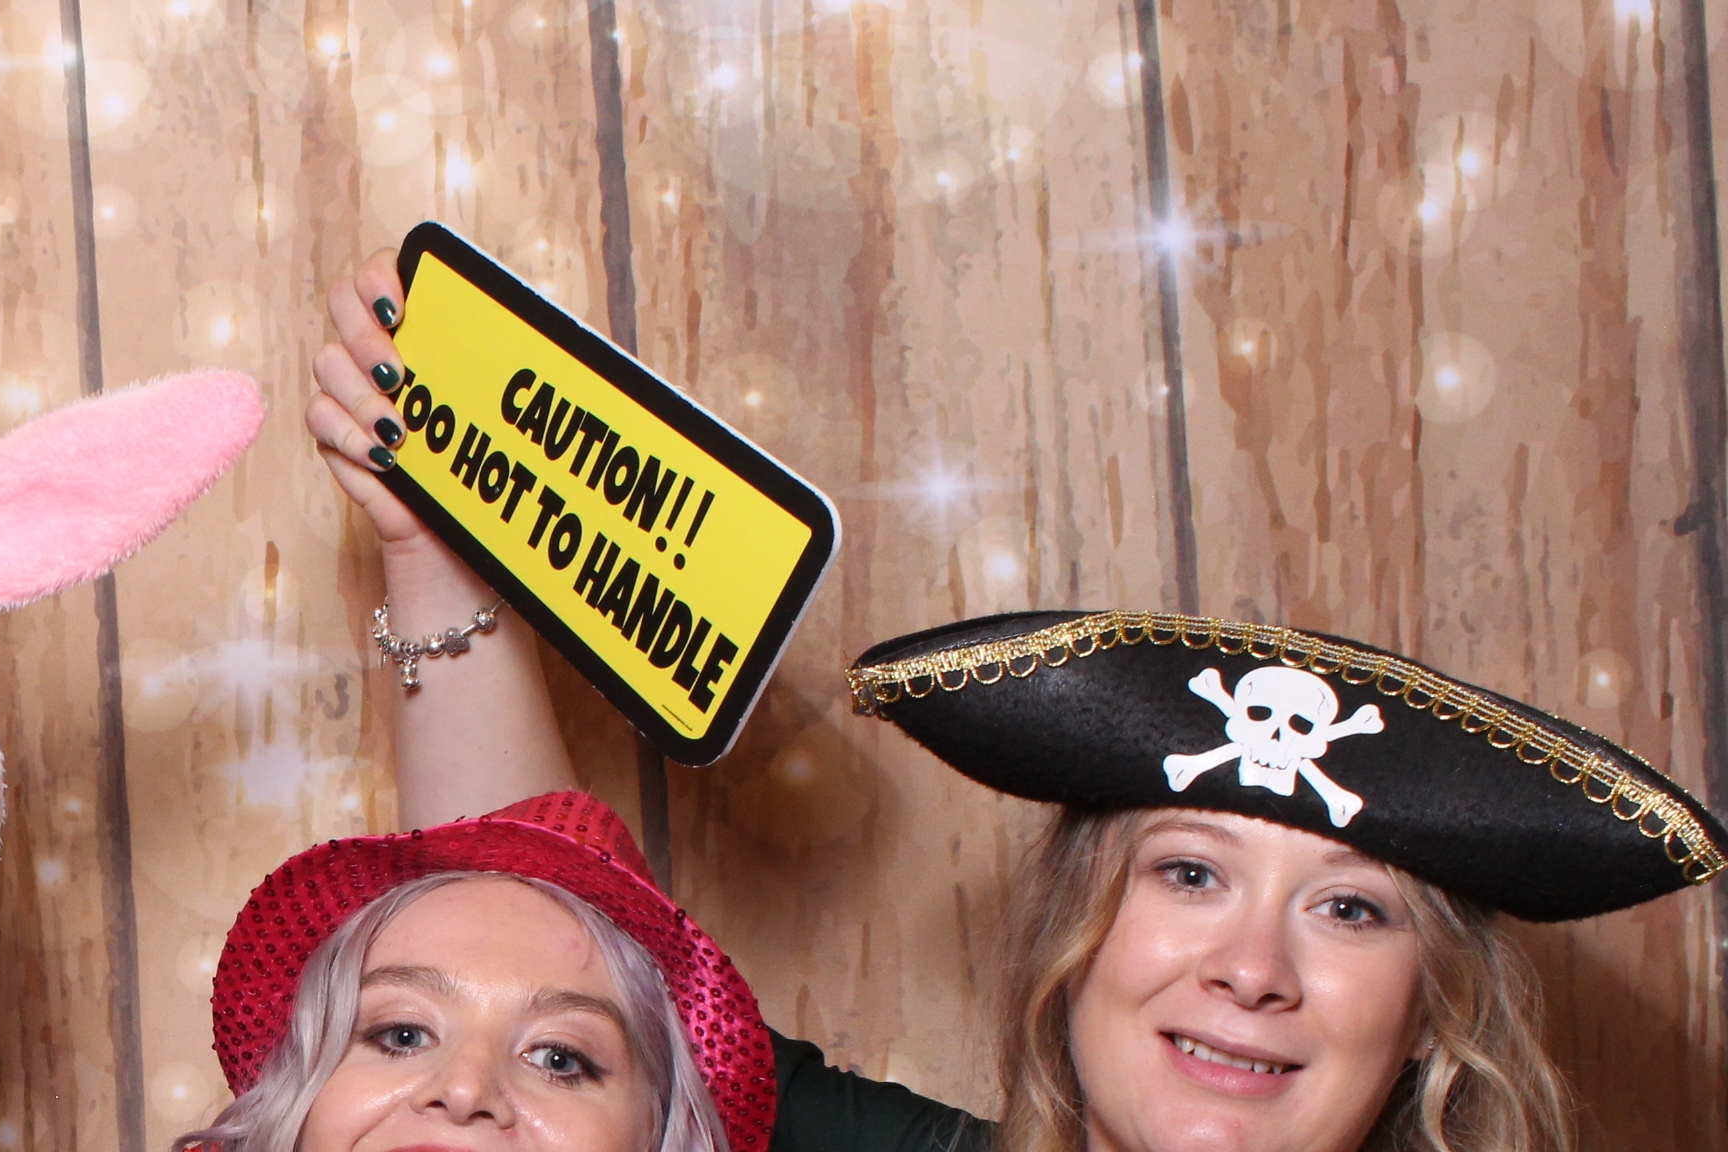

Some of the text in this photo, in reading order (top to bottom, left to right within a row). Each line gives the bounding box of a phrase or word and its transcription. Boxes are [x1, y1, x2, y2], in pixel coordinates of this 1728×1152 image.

[450, 422, 538, 523] HOT
[527, 484, 583, 570] TO
[573, 531, 739, 714] HANDLE
[501, 368, 715, 570] CAUTION!!
